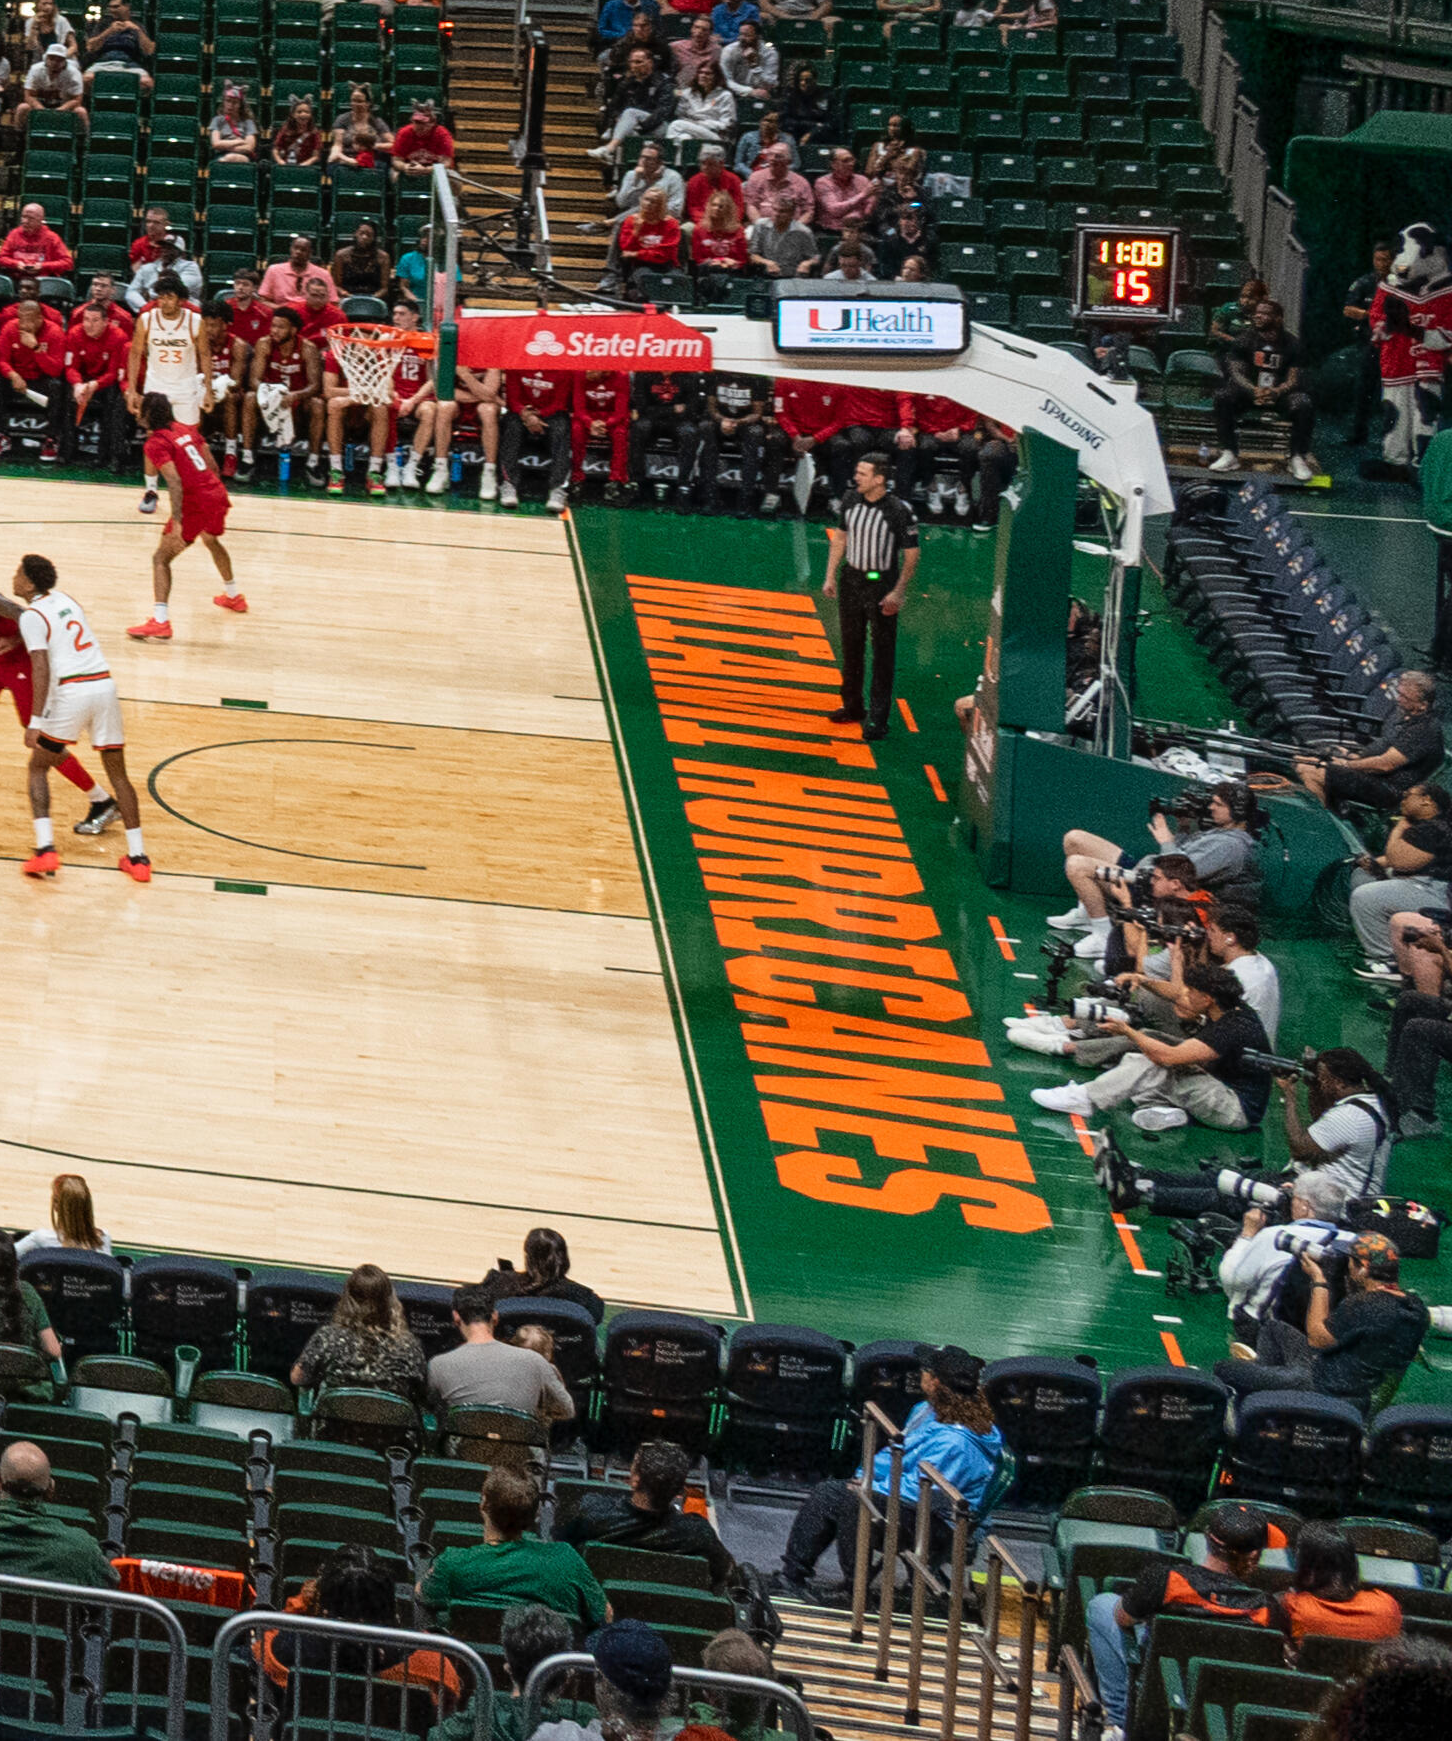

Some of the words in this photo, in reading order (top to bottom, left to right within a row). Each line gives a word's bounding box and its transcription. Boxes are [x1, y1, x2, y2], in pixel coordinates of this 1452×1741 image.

[1099, 240, 1164, 267] 11:08
[1115, 270, 1151, 303] 15
[808, 307, 933, 333] UHealth
[151, 338, 188, 348] CANES
[158, 349, 183, 364] 23
[400, 362, 420, 380] 12
[1039, 398, 1106, 450] SPALDING
[185, 443, 207, 472] 8
[65, 619, 92, 651] 2
[626, 574, 877, 770] MIAMI
[672, 758, 1054, 1235] HURRICANES
